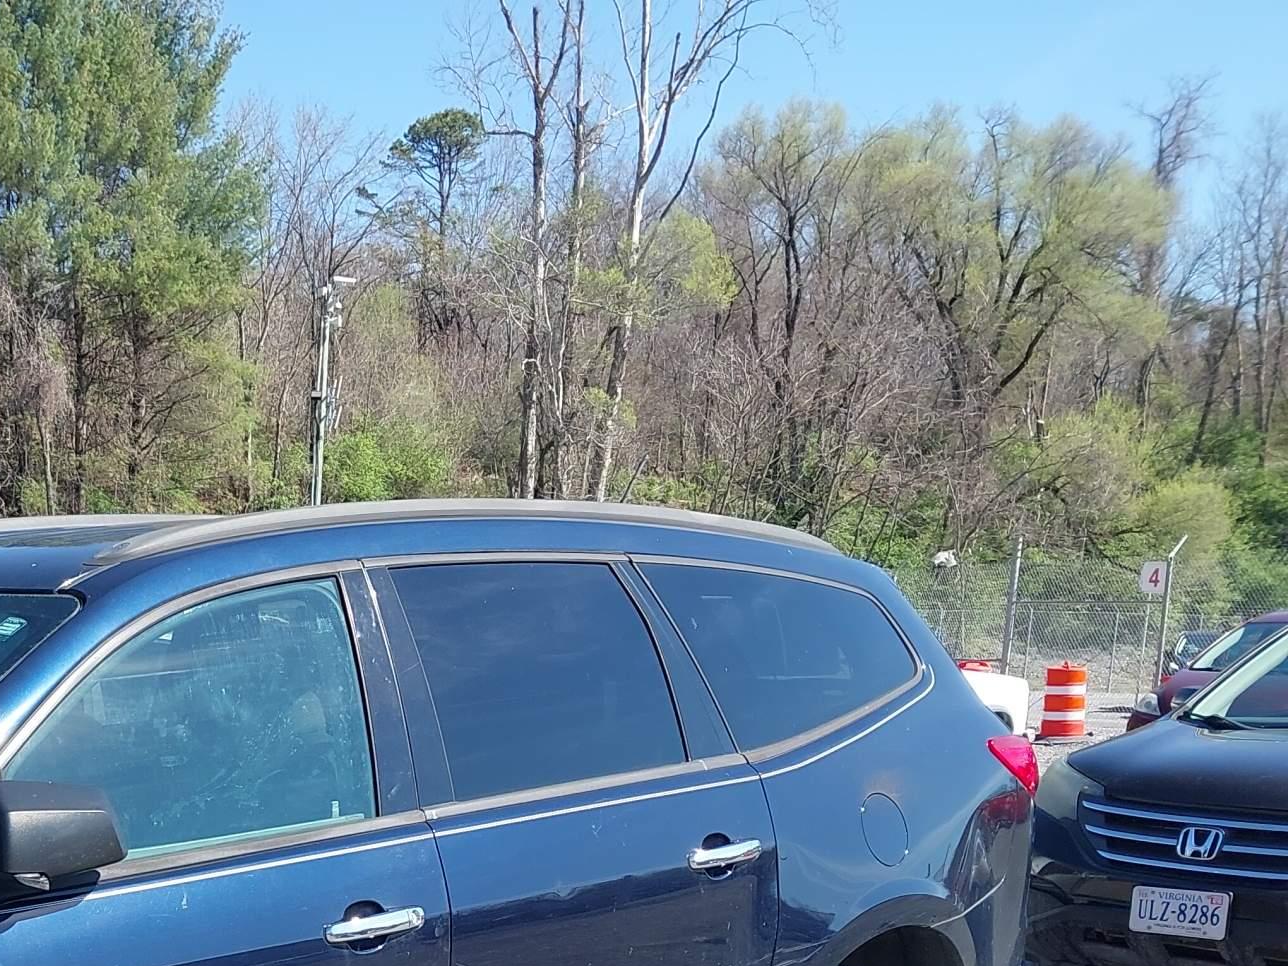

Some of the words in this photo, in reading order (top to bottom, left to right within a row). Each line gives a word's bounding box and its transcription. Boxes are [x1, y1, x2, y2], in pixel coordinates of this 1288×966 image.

[1148, 567, 1160, 588] 4
[1158, 891, 1204, 904] VIRGINIA
[1137, 898, 1222, 926] ULZ-8286
